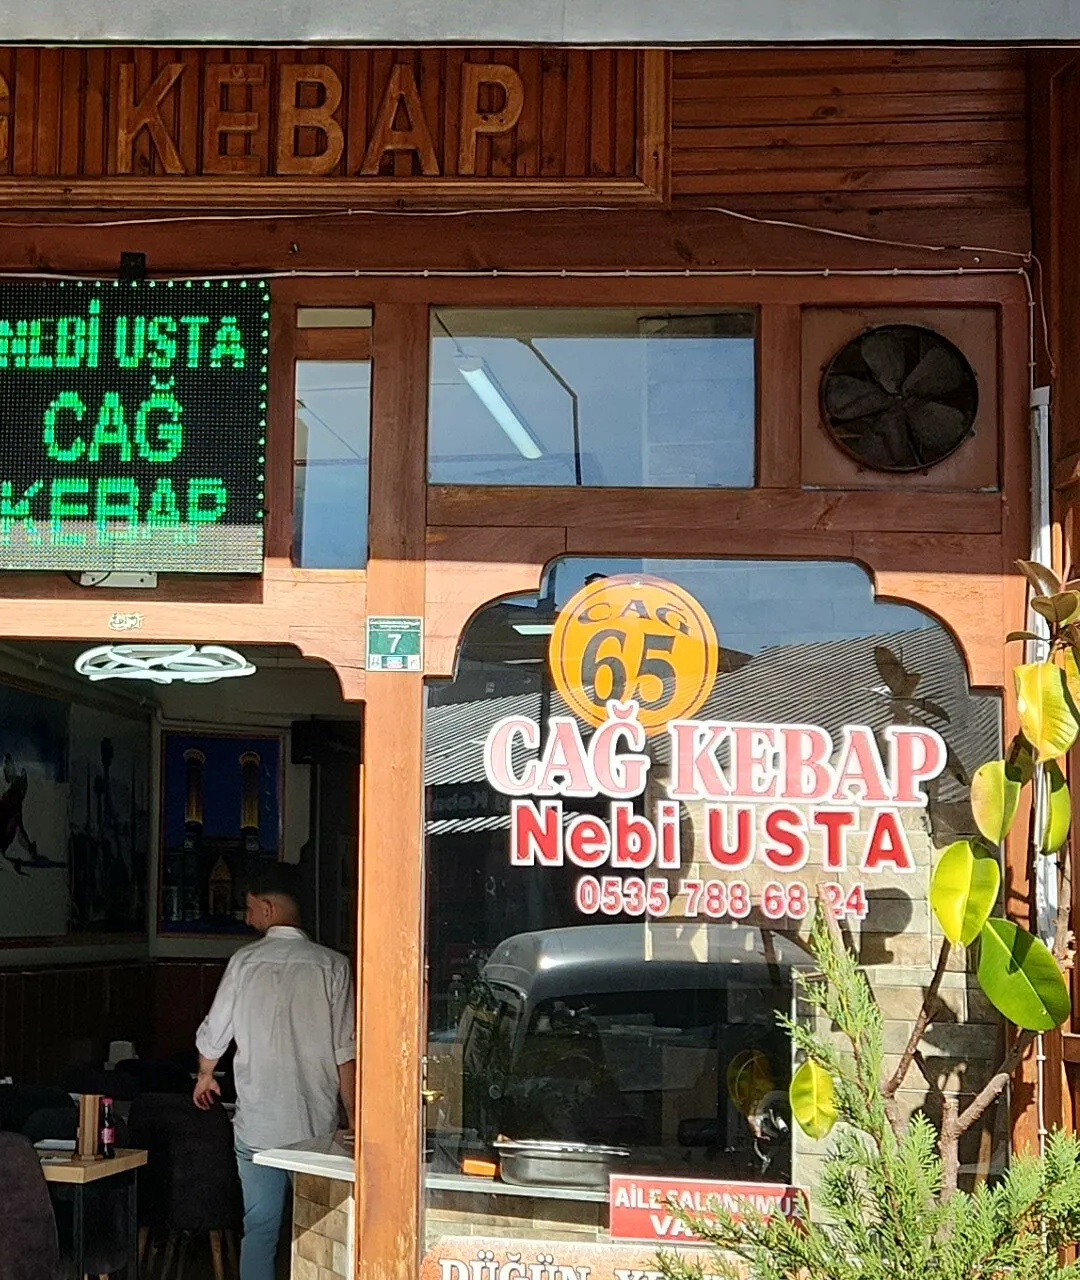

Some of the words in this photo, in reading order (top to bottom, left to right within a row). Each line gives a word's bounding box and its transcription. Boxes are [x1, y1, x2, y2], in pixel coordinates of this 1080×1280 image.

[118, 62, 525, 176] KEBAP
[116, 316, 245, 368] USTA
[43, 375, 184, 462] CAĞ
[0, 478, 228, 546] KEBAP
[387, 633, 402, 654] 7
[580, 629, 677, 712] 65
[486, 702, 650, 797] CAĞ
[668, 722, 946, 805] KEBAP
[512, 801, 679, 868] Nebi
[705, 805, 914, 871] USTA
[577, 876, 669, 914] 0535
[684, 878, 750, 917] 788
[762, 881, 808, 919] 68
